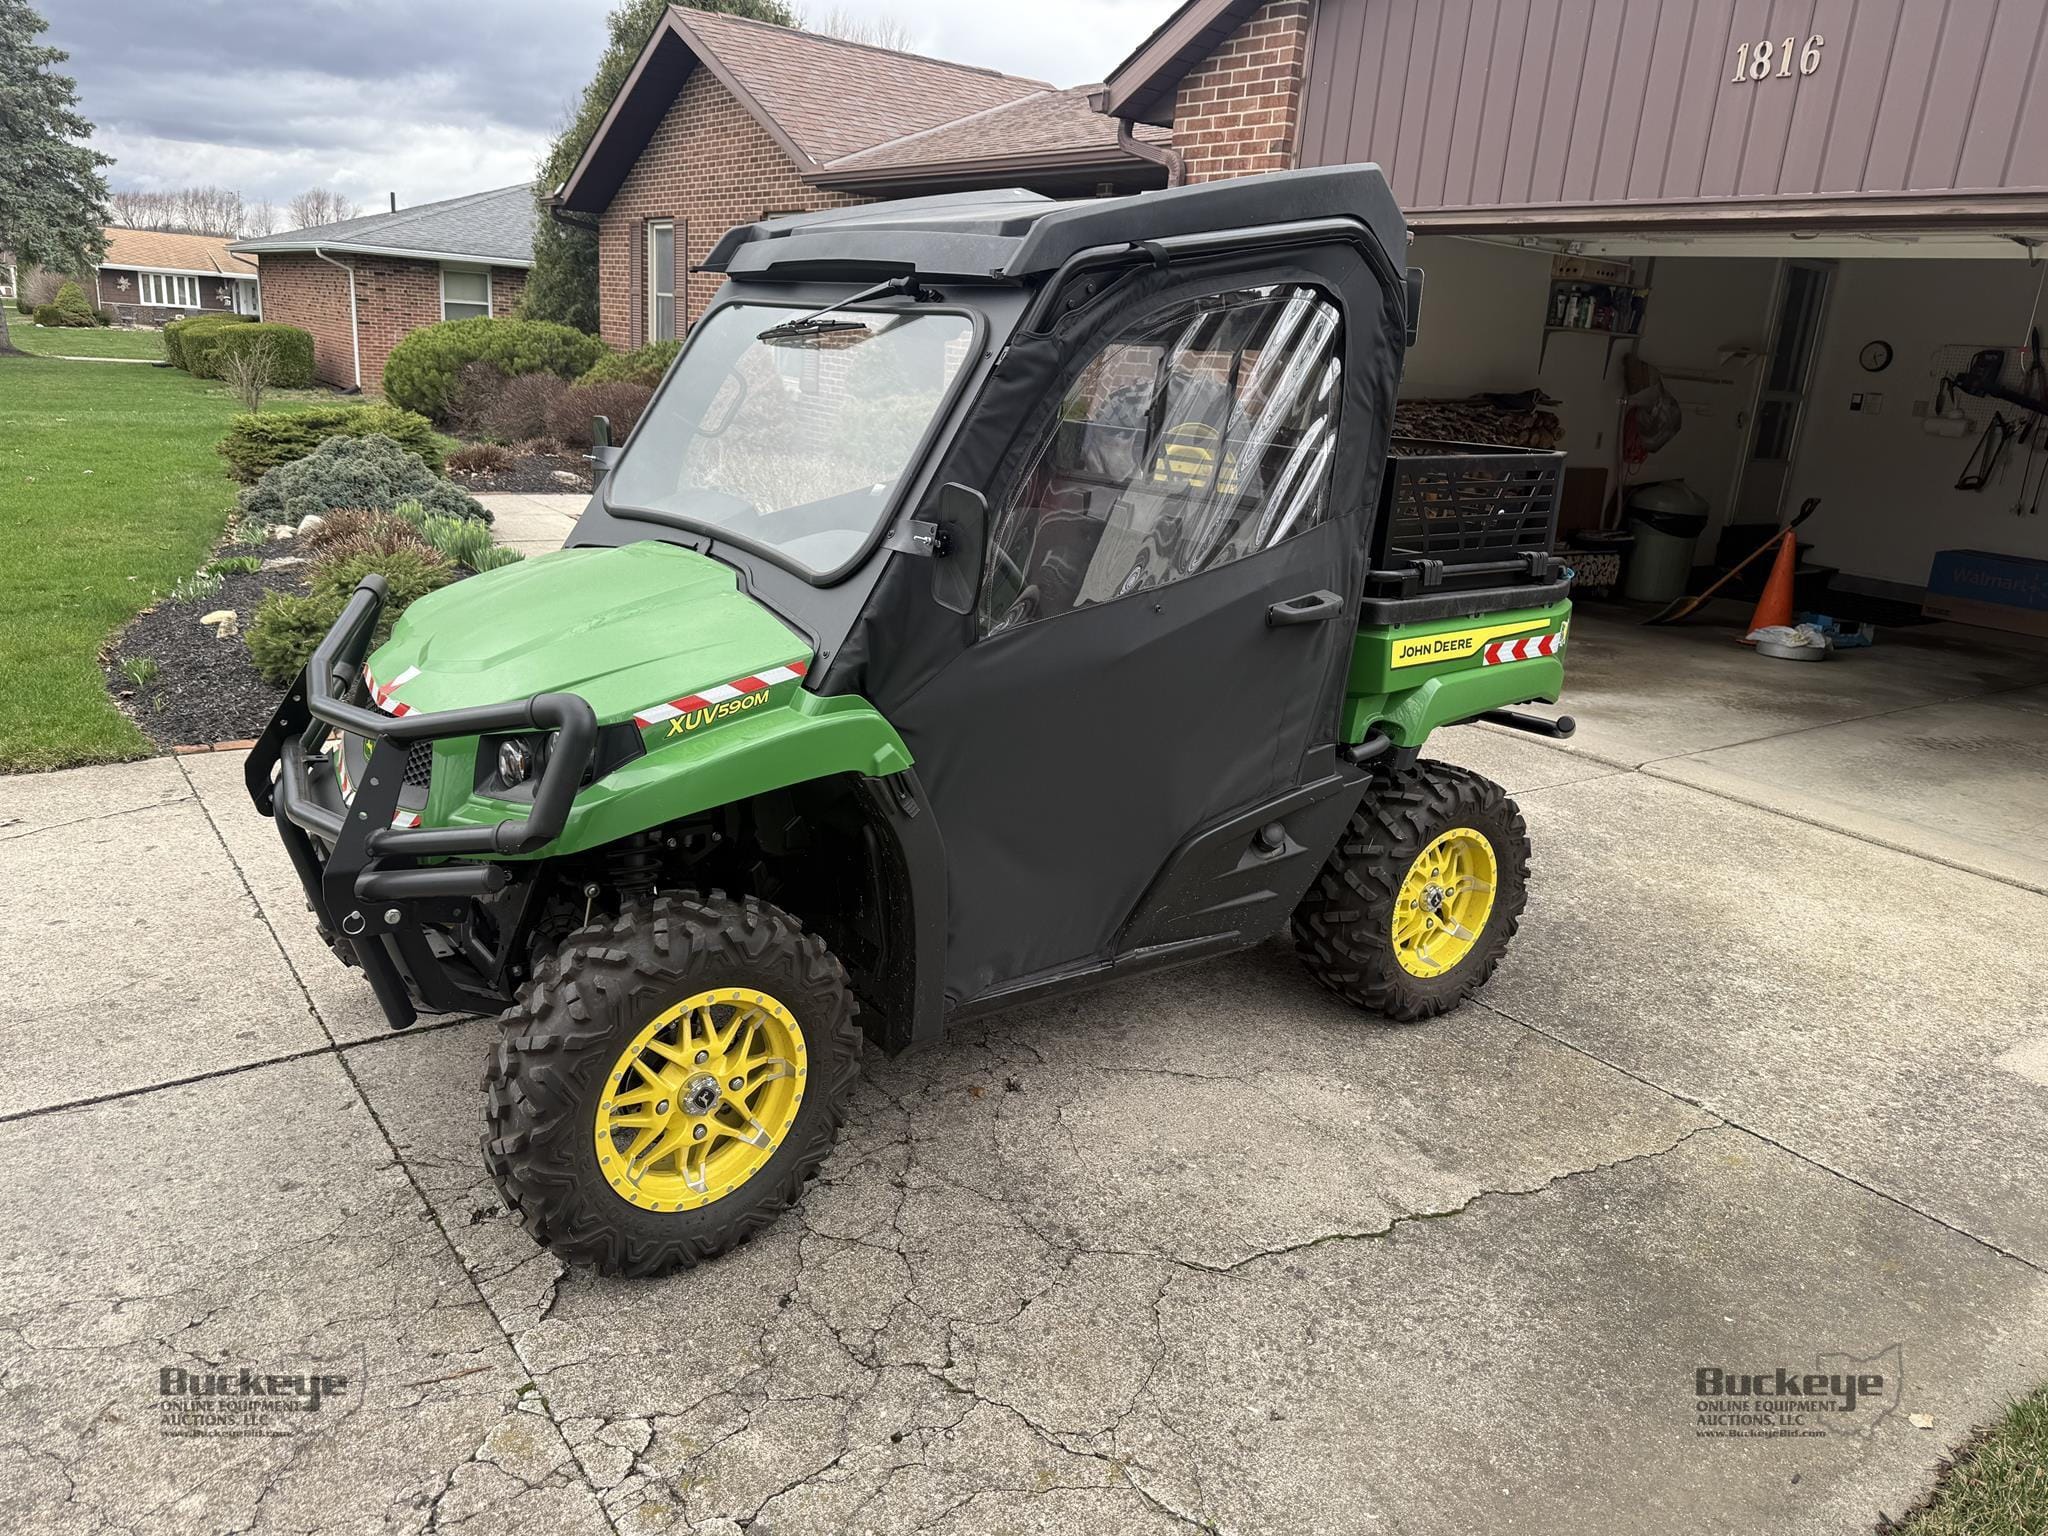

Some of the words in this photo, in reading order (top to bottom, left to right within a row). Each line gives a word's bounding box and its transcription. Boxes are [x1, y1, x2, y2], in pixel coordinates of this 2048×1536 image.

[1731, 34, 1824, 83] 1816
[1953, 568, 2028, 592] Walmart
[1399, 644, 1431, 658] JOHN
[1434, 638, 1472, 652] DEERE
[665, 690, 770, 738] XUV590M
